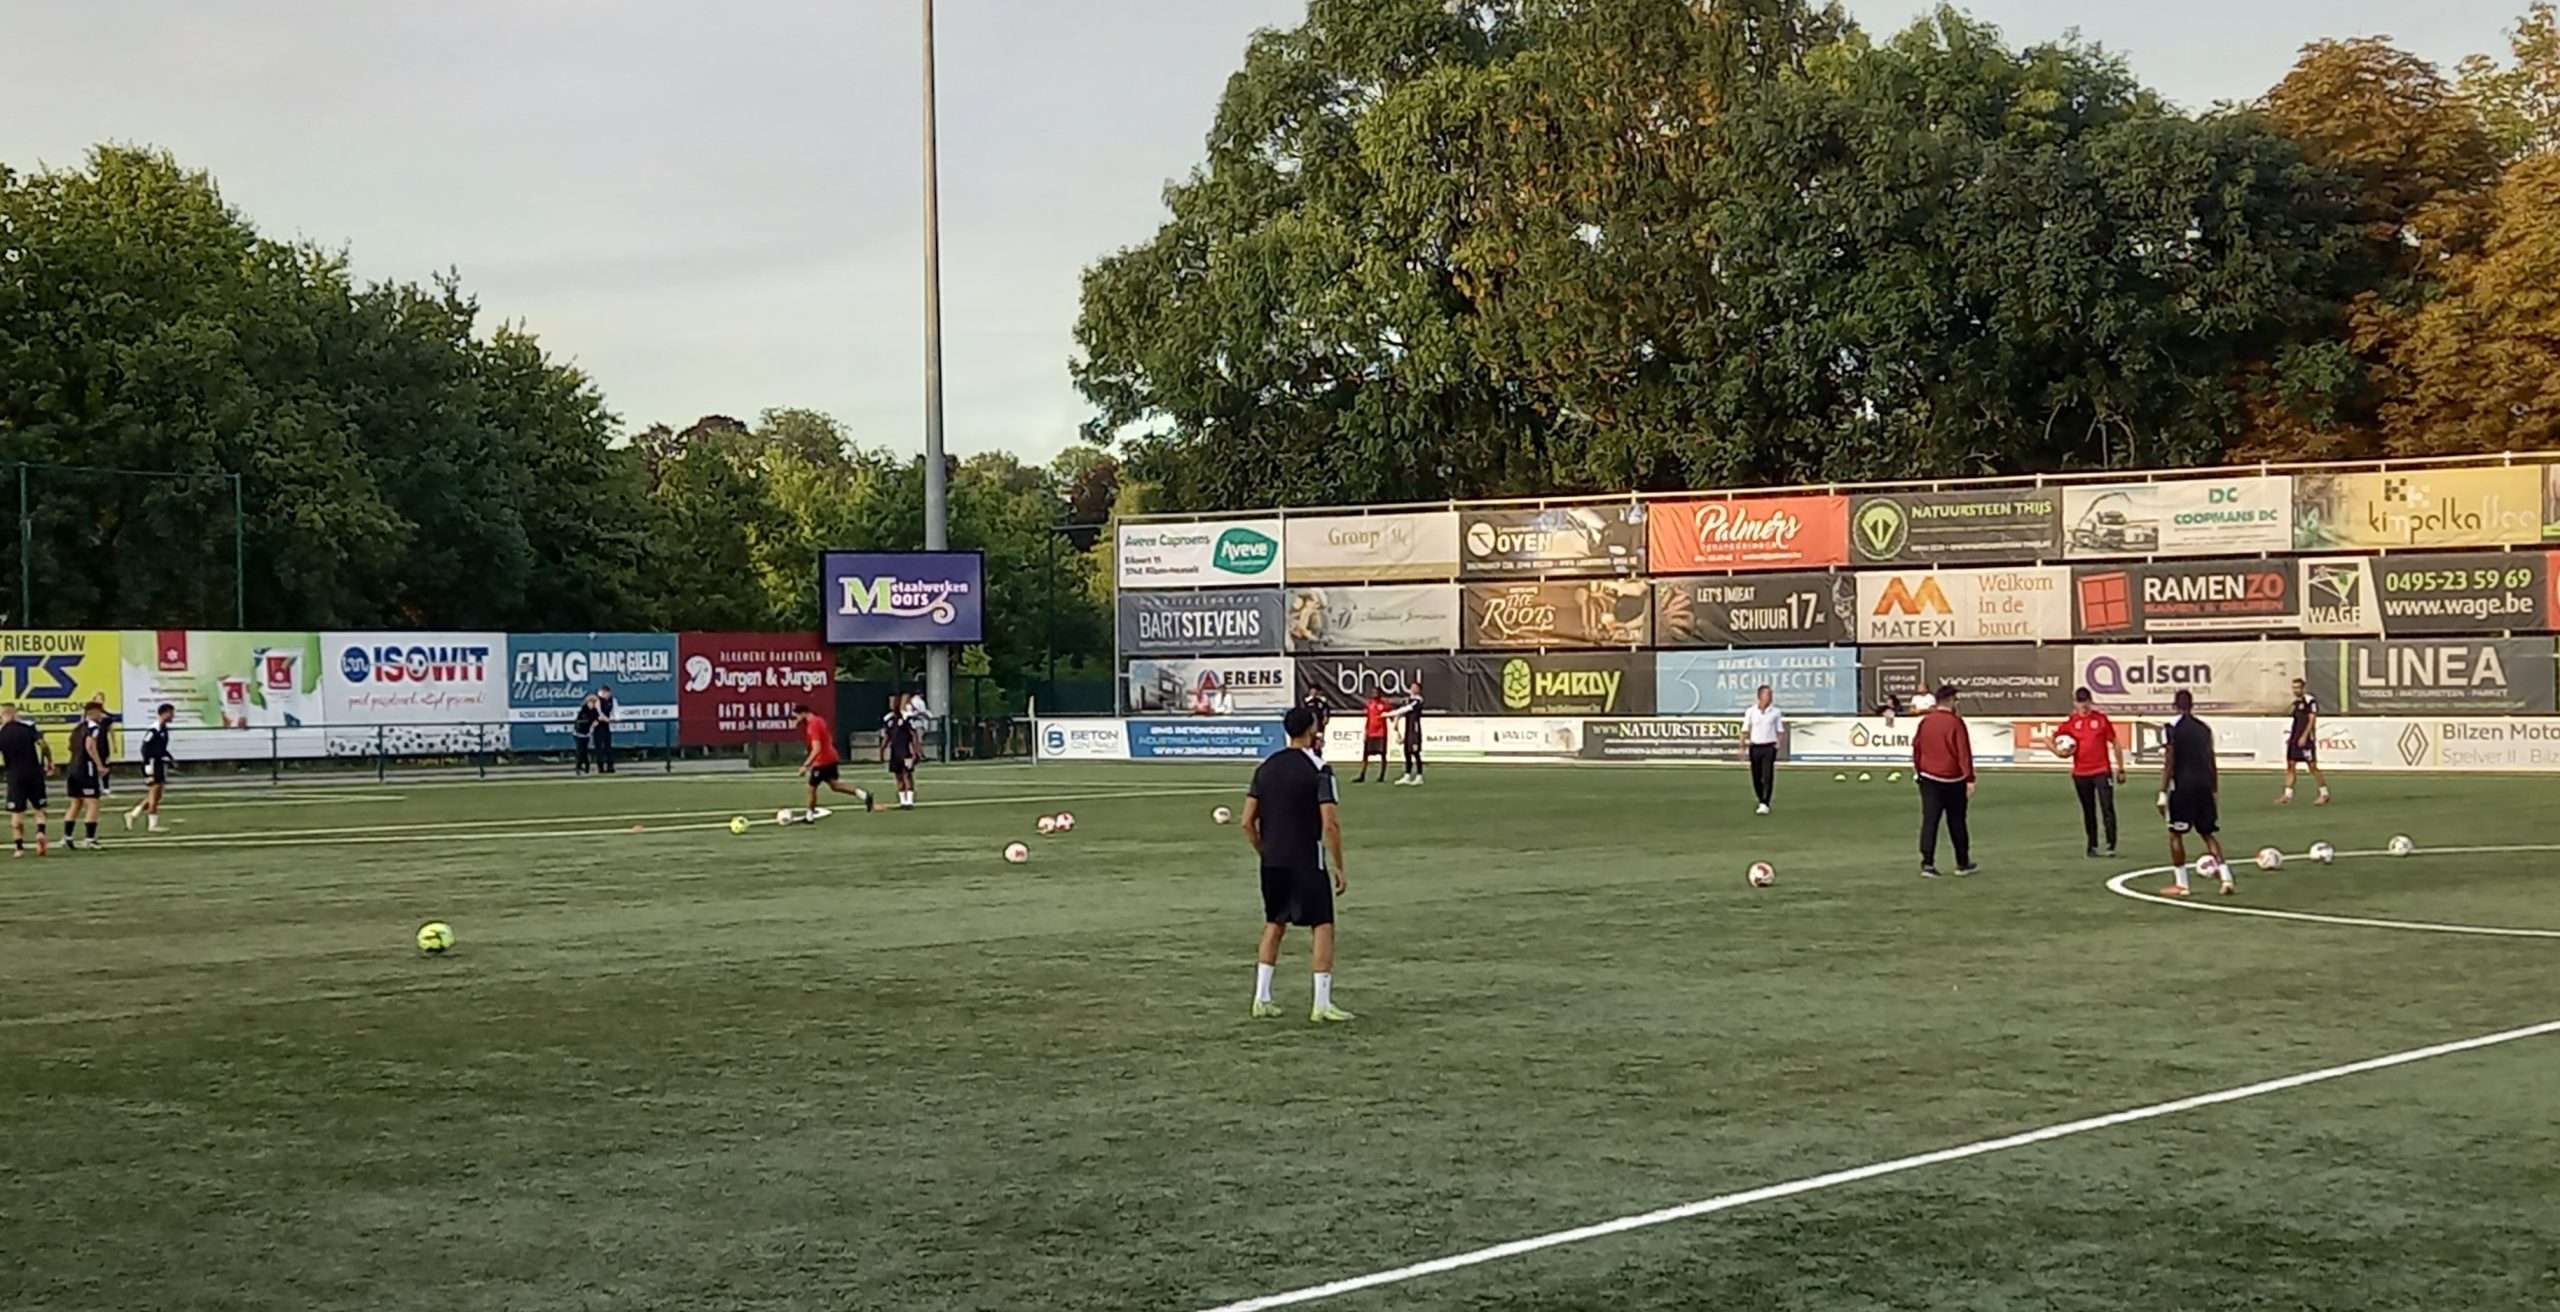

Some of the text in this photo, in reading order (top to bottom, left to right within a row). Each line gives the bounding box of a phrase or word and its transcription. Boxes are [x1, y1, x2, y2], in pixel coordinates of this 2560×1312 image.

[2209, 488, 2238, 503] DC
[2174, 510, 2278, 525] COOPMANS DC
[1220, 541, 1268, 559] Aveve
[1978, 573, 2054, 593] Welkom
[2143, 572, 2285, 602] RAMENZO
[2385, 568, 2533, 592] 0495-23 59 69
[1978, 599, 2024, 615] in de
[2384, 592, 2534, 619] www.wage.be
[2308, 607, 2361, 625] WAGE
[1872, 620, 1955, 639] MATEXI
[374, 646, 489, 682] ISOWIT
[2126, 655, 2212, 684] alsan
[2358, 646, 2508, 687] LINEA
[0, 655, 86, 700] TS
[1333, 730, 1363, 741] BET
[1871, 735, 1914, 748] CLIM
[2442, 723, 2504, 741] Bilzen
